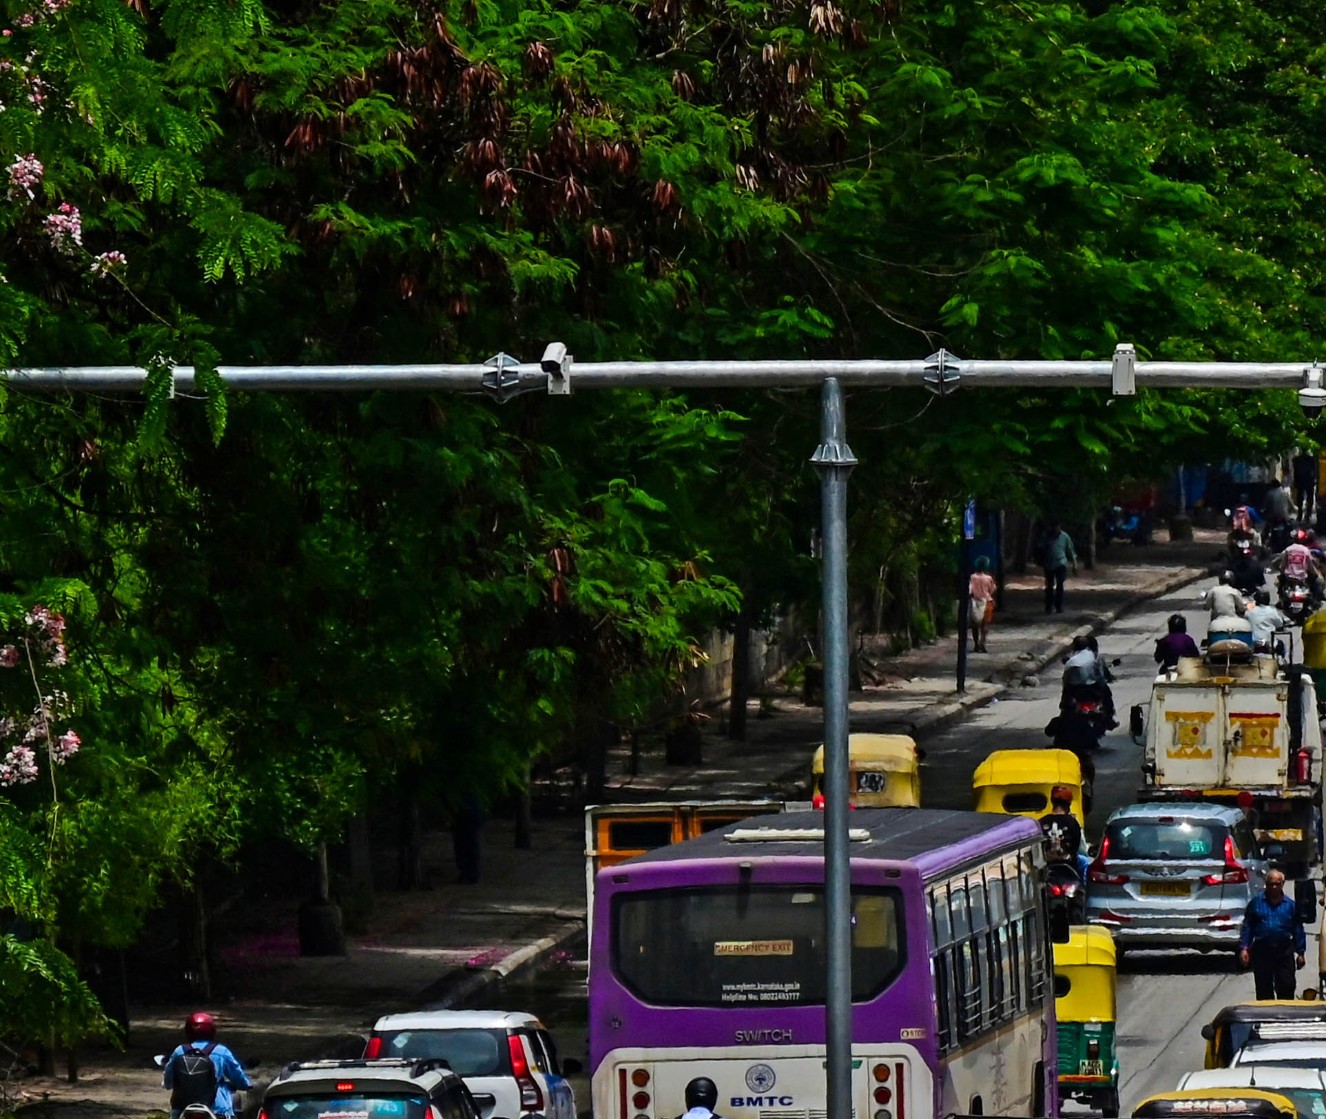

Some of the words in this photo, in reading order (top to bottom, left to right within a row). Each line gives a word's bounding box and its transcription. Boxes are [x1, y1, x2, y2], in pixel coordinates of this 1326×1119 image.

[772, 943, 791, 952] EXIT
[735, 1029, 793, 1043] SWITCH
[730, 1096, 794, 1108] BMTC
[376, 1103, 398, 1113] 743
